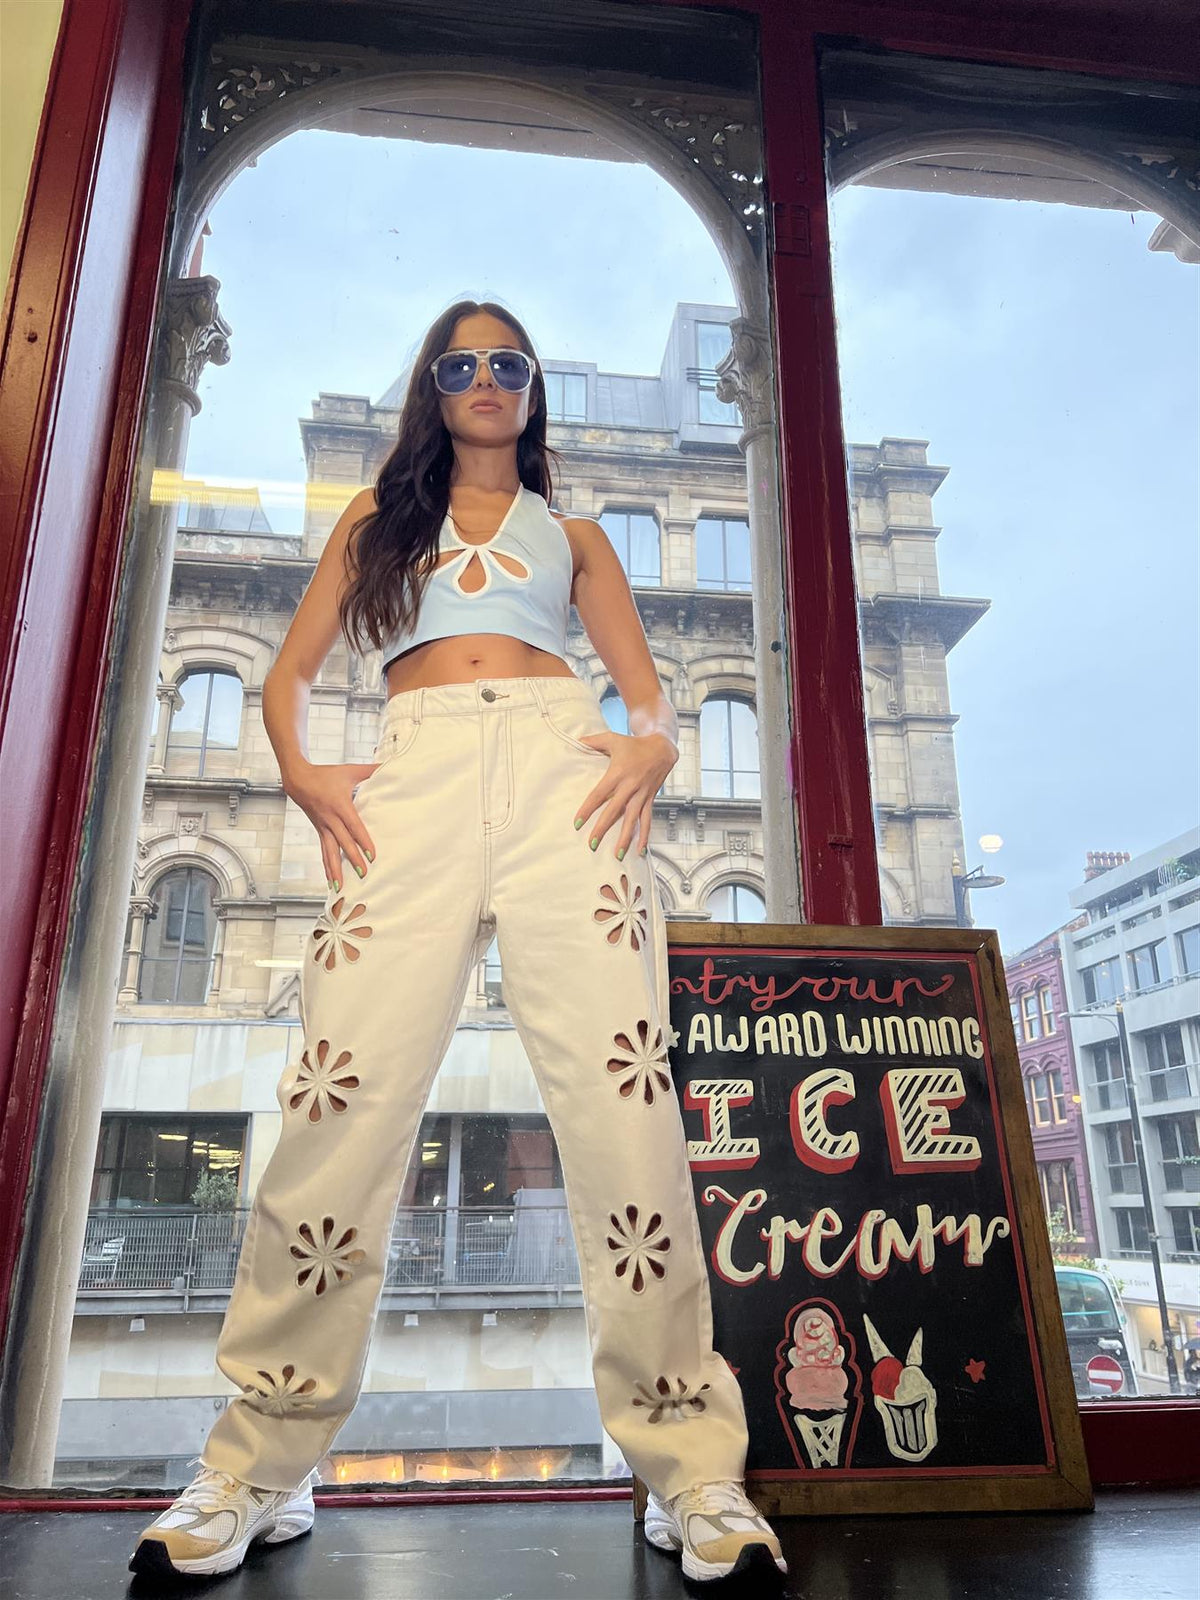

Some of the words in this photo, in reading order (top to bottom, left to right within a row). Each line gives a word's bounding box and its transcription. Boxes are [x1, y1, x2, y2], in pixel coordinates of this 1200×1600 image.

[670, 957, 790, 1012] try
[798, 973, 955, 1007] our
[687, 1010, 827, 1057] AWARD
[835, 1012, 985, 1059] WINNING
[683, 1067, 982, 1175] ICE
[701, 1185, 1010, 1287] Cream
